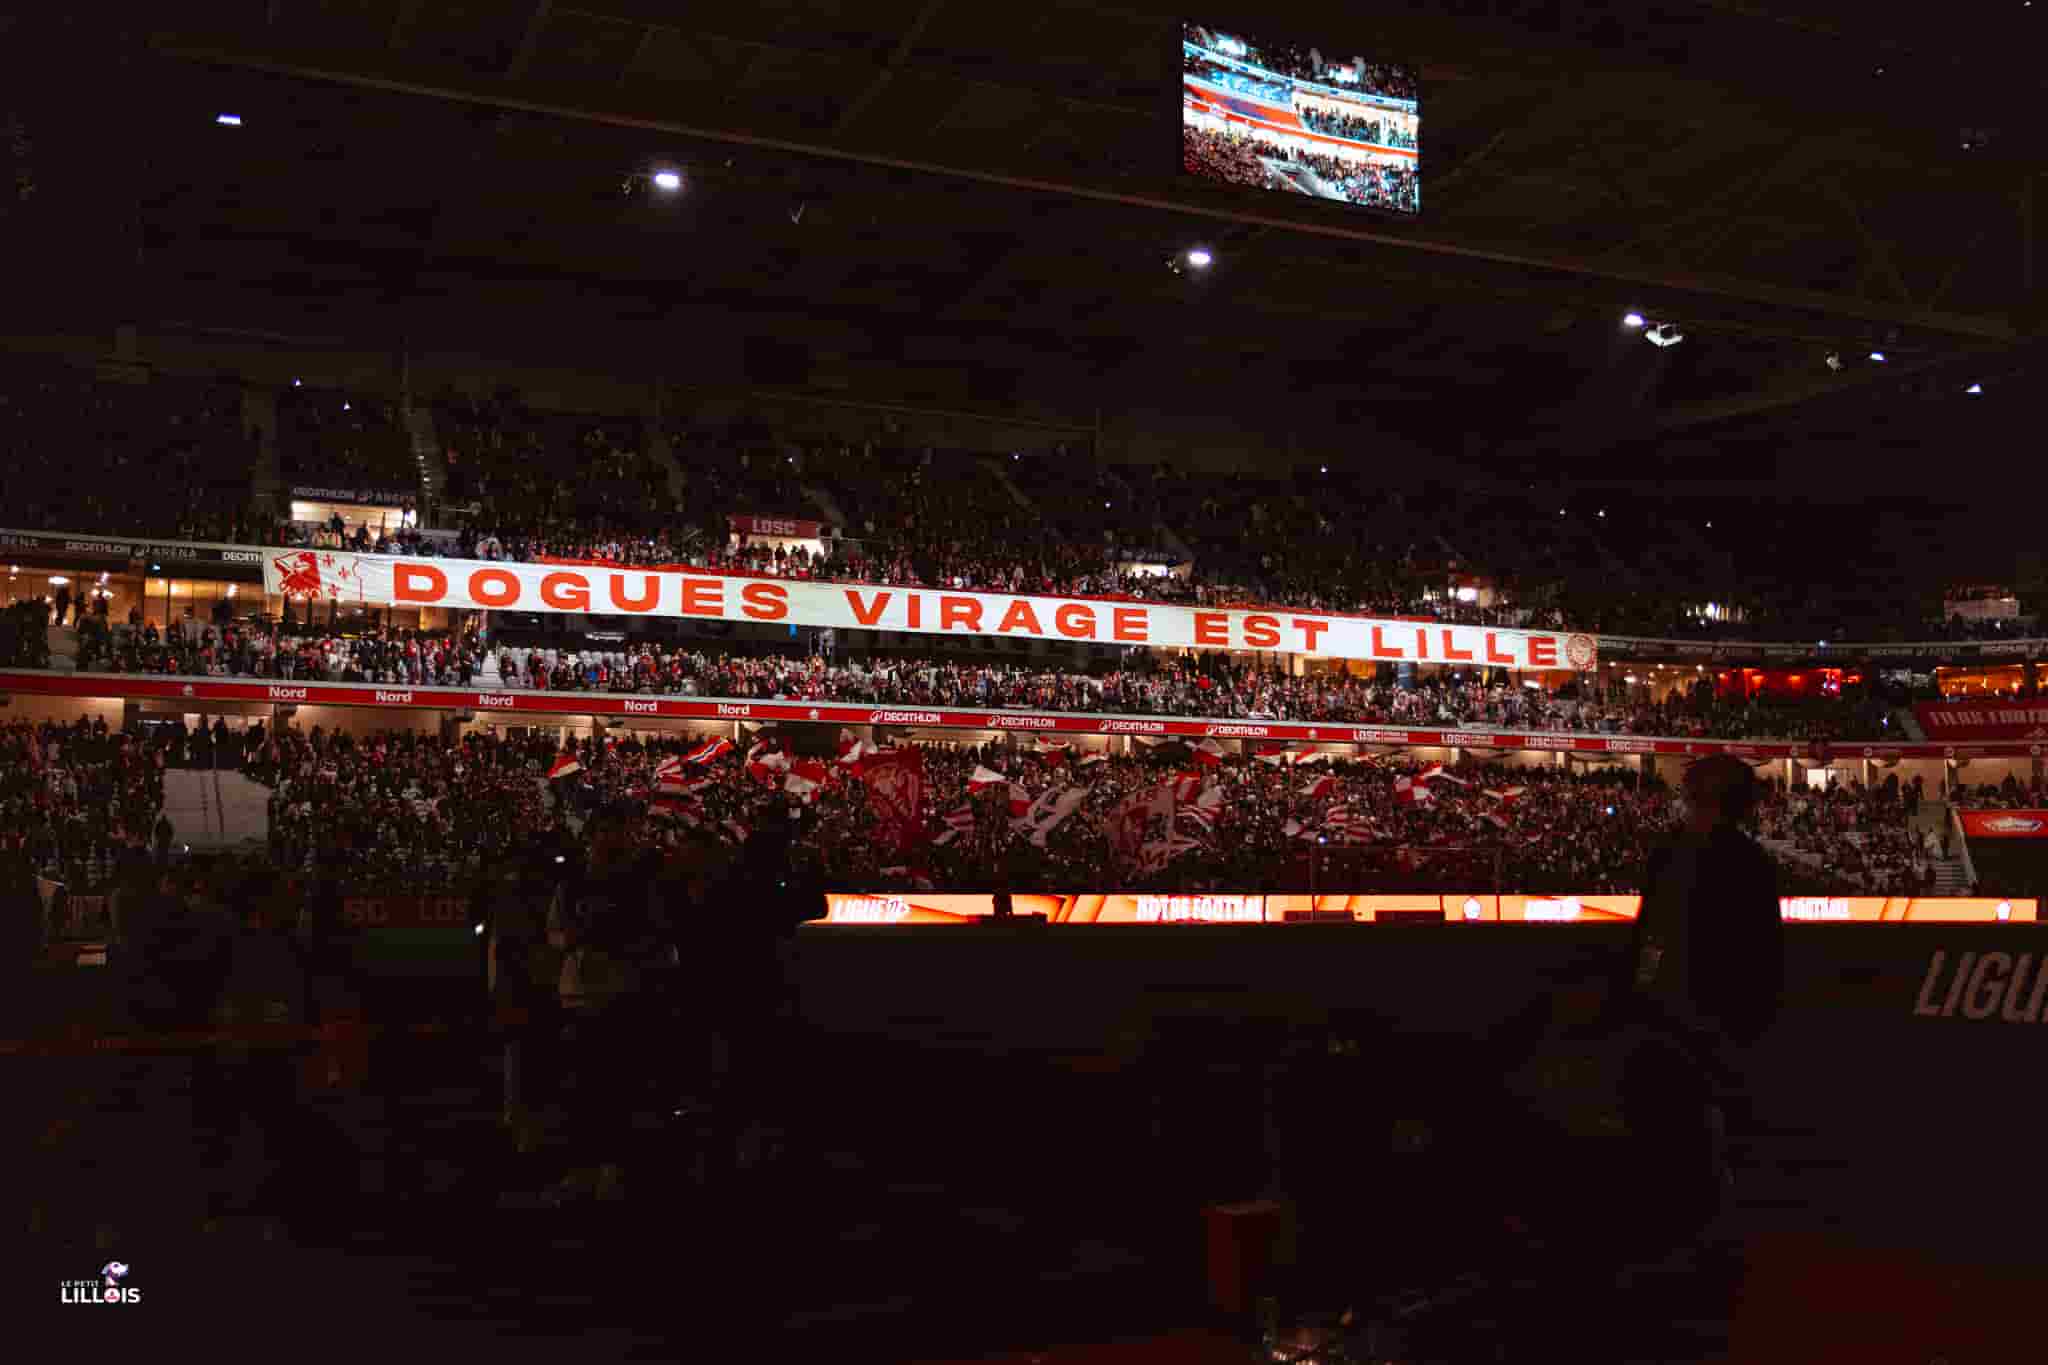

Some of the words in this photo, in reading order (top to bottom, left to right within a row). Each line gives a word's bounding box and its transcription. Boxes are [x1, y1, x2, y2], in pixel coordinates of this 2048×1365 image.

[391, 561, 790, 622] DOGUES
[843, 590, 1150, 642] VIRAGE
[1193, 612, 1330, 652] EST
[1370, 626, 1559, 667] LILLE
[269, 686, 307, 699] Nord
[375, 690, 412, 703] Nord
[479, 694, 513, 706] Nord
[624, 700, 657, 713] Nord
[718, 703, 750, 715] Nord
[884, 711, 941, 723] DECATHLON
[1001, 715, 1056, 728] DECATHLON
[1112, 721, 1164, 732] DECATHLON
[1219, 725, 1268, 737] DECATHLON
[1352, 729, 1381, 743] LOSC
[1913, 951, 2048, 1023] LIGU
